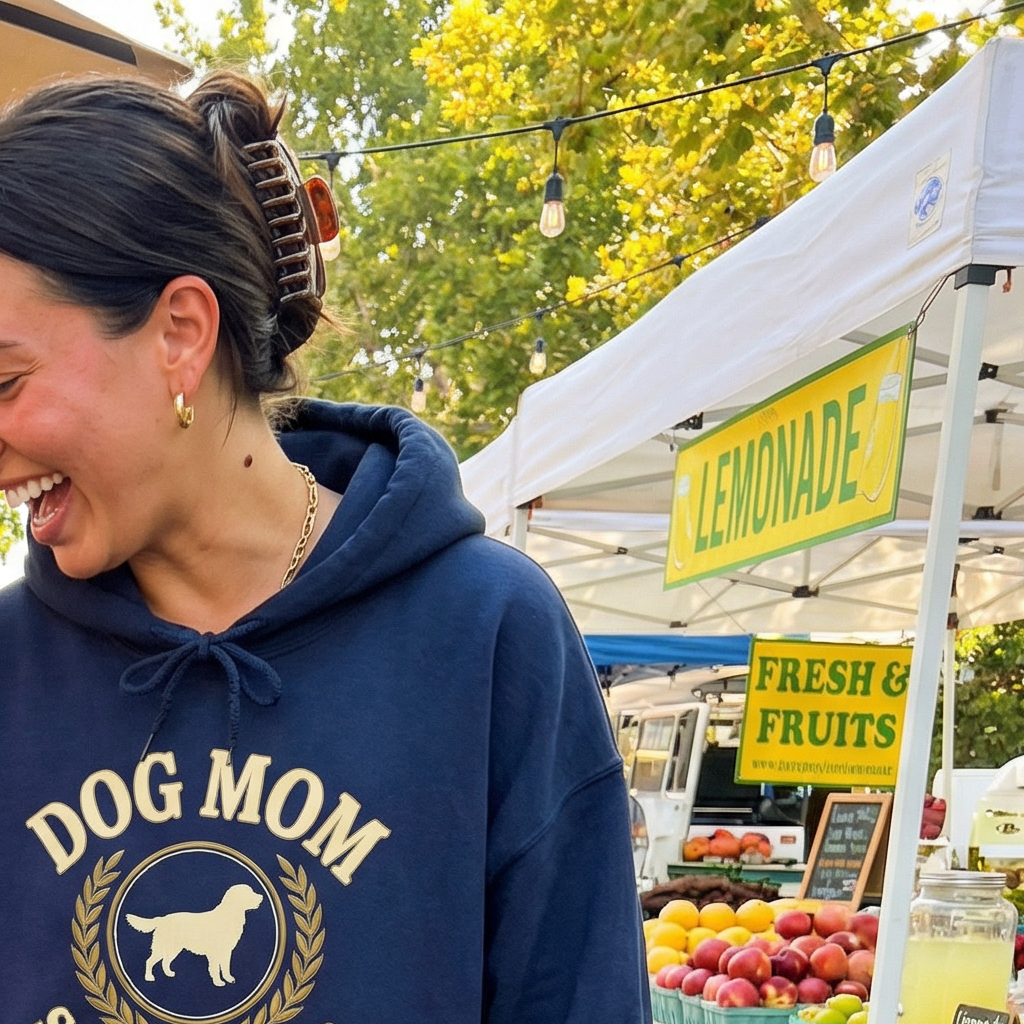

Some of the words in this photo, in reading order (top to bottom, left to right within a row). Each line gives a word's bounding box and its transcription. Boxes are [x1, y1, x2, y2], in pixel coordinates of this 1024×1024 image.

[694, 383, 867, 554] LEMONADE
[755, 656, 876, 697] FRESH
[881, 661, 911, 697] &
[756, 708, 897, 749] FRUITS
[25, 751, 183, 875] DOG
[199, 748, 391, 886] MOM
